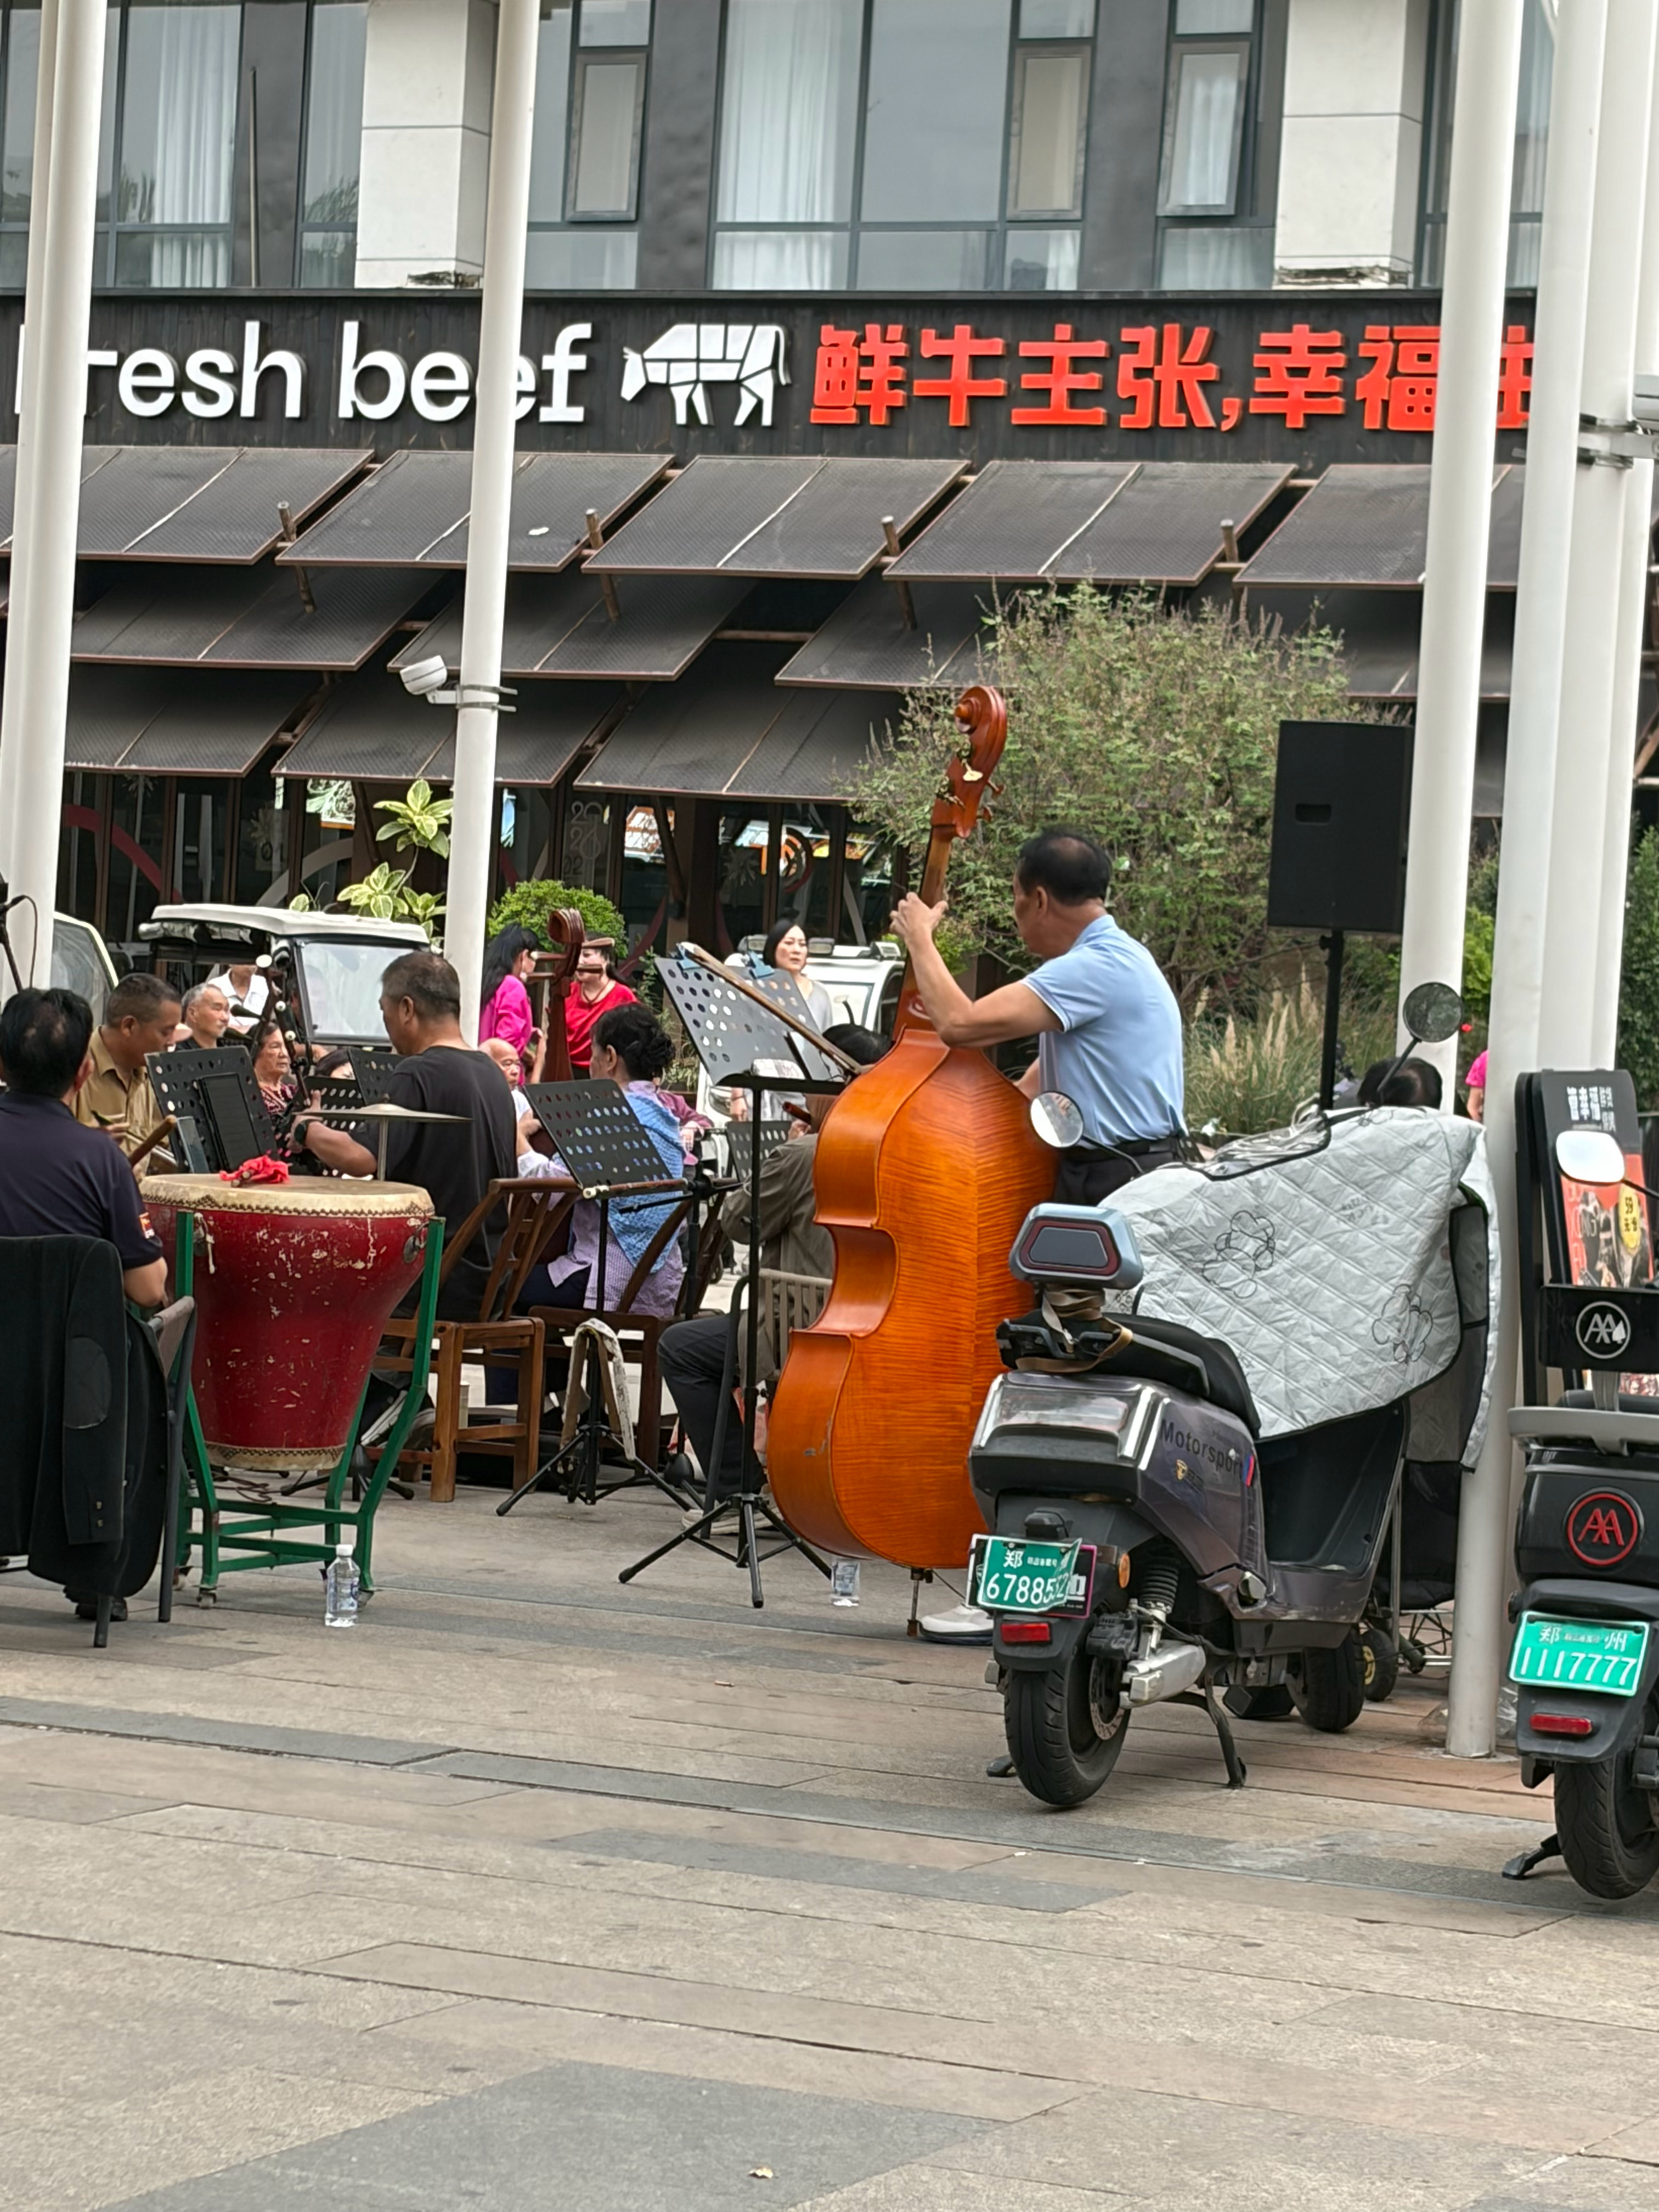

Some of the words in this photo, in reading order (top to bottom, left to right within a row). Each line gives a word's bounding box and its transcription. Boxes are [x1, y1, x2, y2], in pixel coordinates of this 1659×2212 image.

[1160, 1418, 1244, 1483] Motorsport
[1003, 1548, 1025, 1570] 郑
[1538, 1624, 1562, 1645] 郑
[1604, 1631, 1628, 1652] 州
[1520, 1646, 1638, 1686] 1117777
